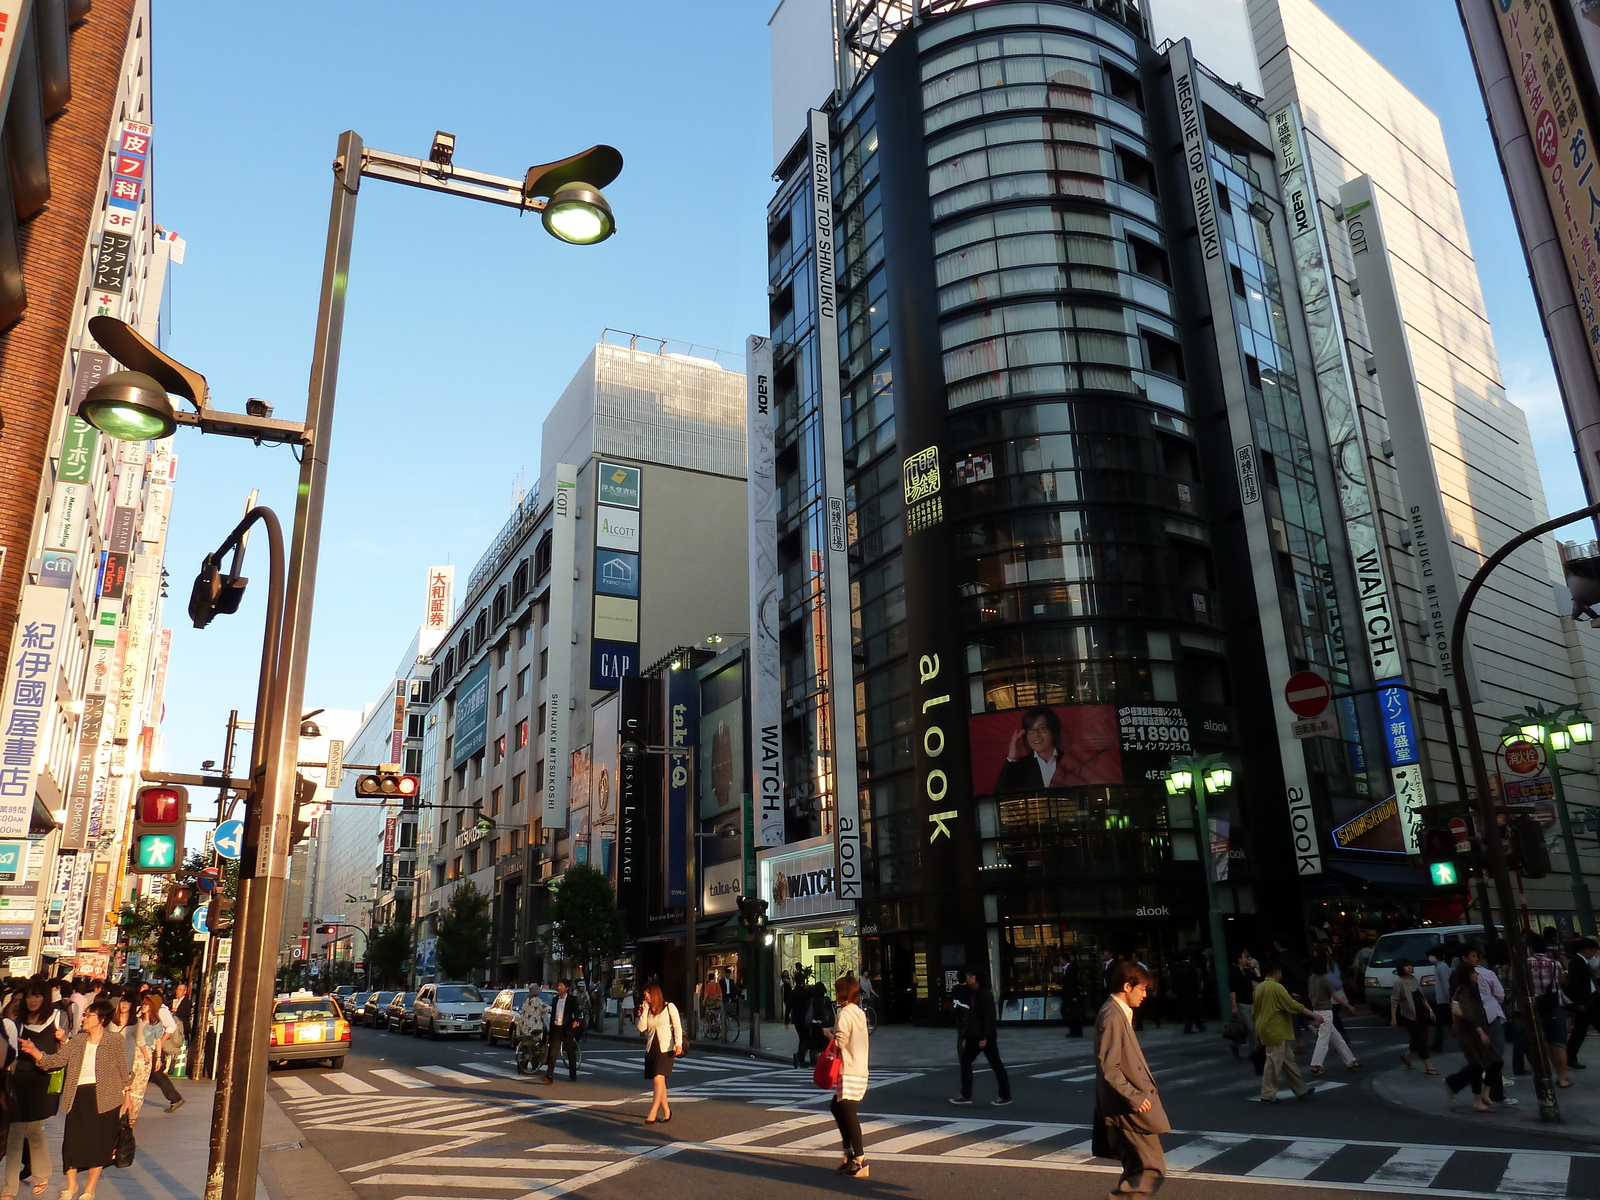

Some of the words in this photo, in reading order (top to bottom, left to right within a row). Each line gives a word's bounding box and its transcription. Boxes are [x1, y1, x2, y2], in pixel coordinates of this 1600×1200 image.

[126, 122, 150, 134] 新宿
[1177, 74, 1199, 143] MEGANE
[1190, 141, 1204, 174] TOP
[1275, 110, 1296, 169] 新盛堂ビル
[115, 135, 149, 200] 皮フ科
[815, 141, 829, 201] MEGANE
[109, 213, 132, 227] 3F
[817, 206, 831, 238] TOP
[1194, 176, 1219, 260] SHINJUKU
[98, 235, 115, 285] コンタクト
[110, 238, 130, 288] プライス
[818, 241, 834, 319] SHINJUKU
[1239, 449, 1257, 501] 眼鏡市場
[556, 478, 576, 518] ALCOTT
[601, 517, 635, 538] ALCOTT
[830, 500, 844, 550] 眼鏡市場
[44, 558, 71, 573] citi
[104, 556, 117, 594] union
[429, 573, 446, 626] 大和証券
[1410, 505, 1434, 578] SHINJUKU
[1427, 583, 1453, 678] MITSUKOSHI
[601, 653, 630, 677] GAP
[0, 621, 56, 797] 紀伊國屋書店
[82, 698, 94, 739] コンタクト
[90, 699, 105, 740] プライス
[549, 692, 559, 742] SHINJUKU
[1203, 719, 1229, 733] alook
[1295, 720, 1335, 737] 自転車を除く
[919, 652, 958, 845] alook
[1123, 742, 1143, 751] オール
[1144, 742, 1157, 751] イン
[1158, 742, 1192, 752] ワンプライス
[1137, 726, 1190, 742] 18900
[1390, 722, 1412, 762] 新盛堂
[81, 754, 92, 772] THE
[1507, 748, 1537, 765] 消火栓
[78, 773, 90, 795] SUIT
[547, 747, 557, 810] MITSUKOSHI
[69, 796, 85, 842] COMPANY
[1288, 786, 1321, 872] alook
[1337, 799, 1398, 846] SHINSEIDO
[623, 806, 636, 884] LANGUAGE
[839, 816, 862, 898] alook
[708, 877, 740, 897] taka-Q
[861, 922, 878, 934] alook
[1136, 905, 1170, 917] alook
